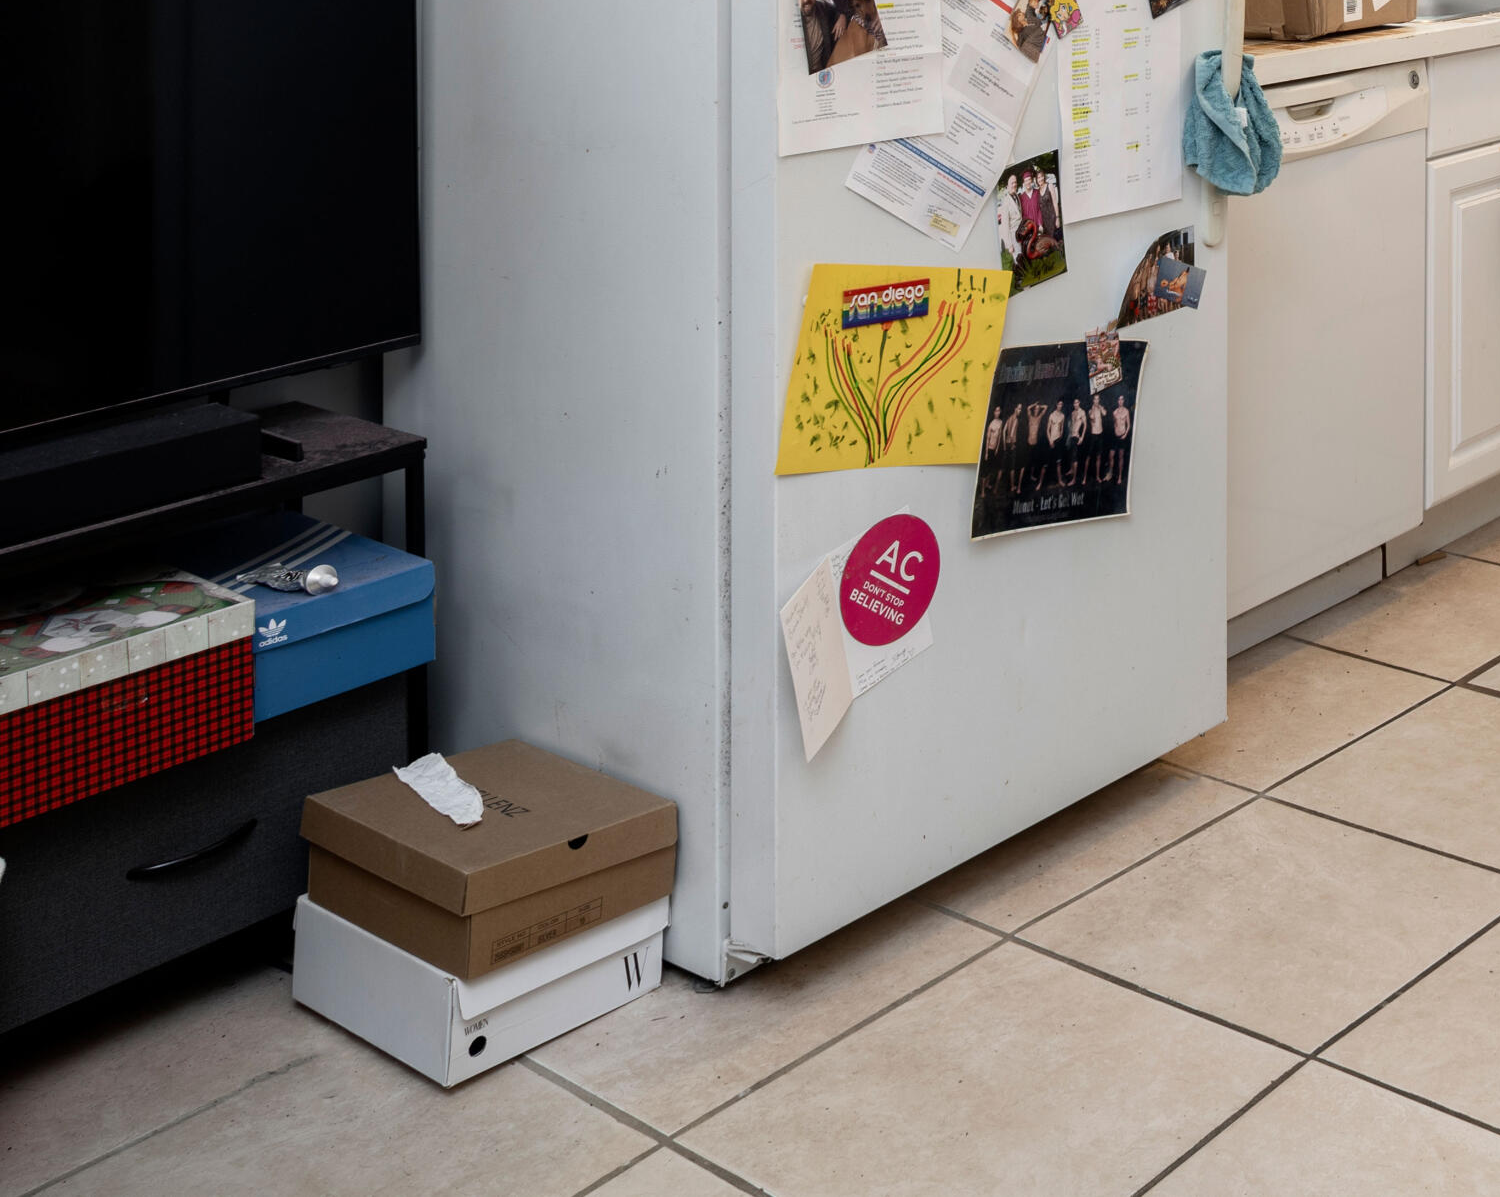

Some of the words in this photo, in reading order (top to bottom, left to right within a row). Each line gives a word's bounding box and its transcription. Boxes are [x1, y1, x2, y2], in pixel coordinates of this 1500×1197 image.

[849, 292, 878, 308] san
[882, 285, 925, 304] diego
[875, 539, 924, 582] AC
[849, 588, 905, 625] BELIEVING
[862, 580, 887, 599] DON'T
[885, 592, 905, 608] STOP
[259, 634, 288, 648] adidas
[623, 946, 649, 992] W
[464, 1017, 489, 1036] WOMEN
